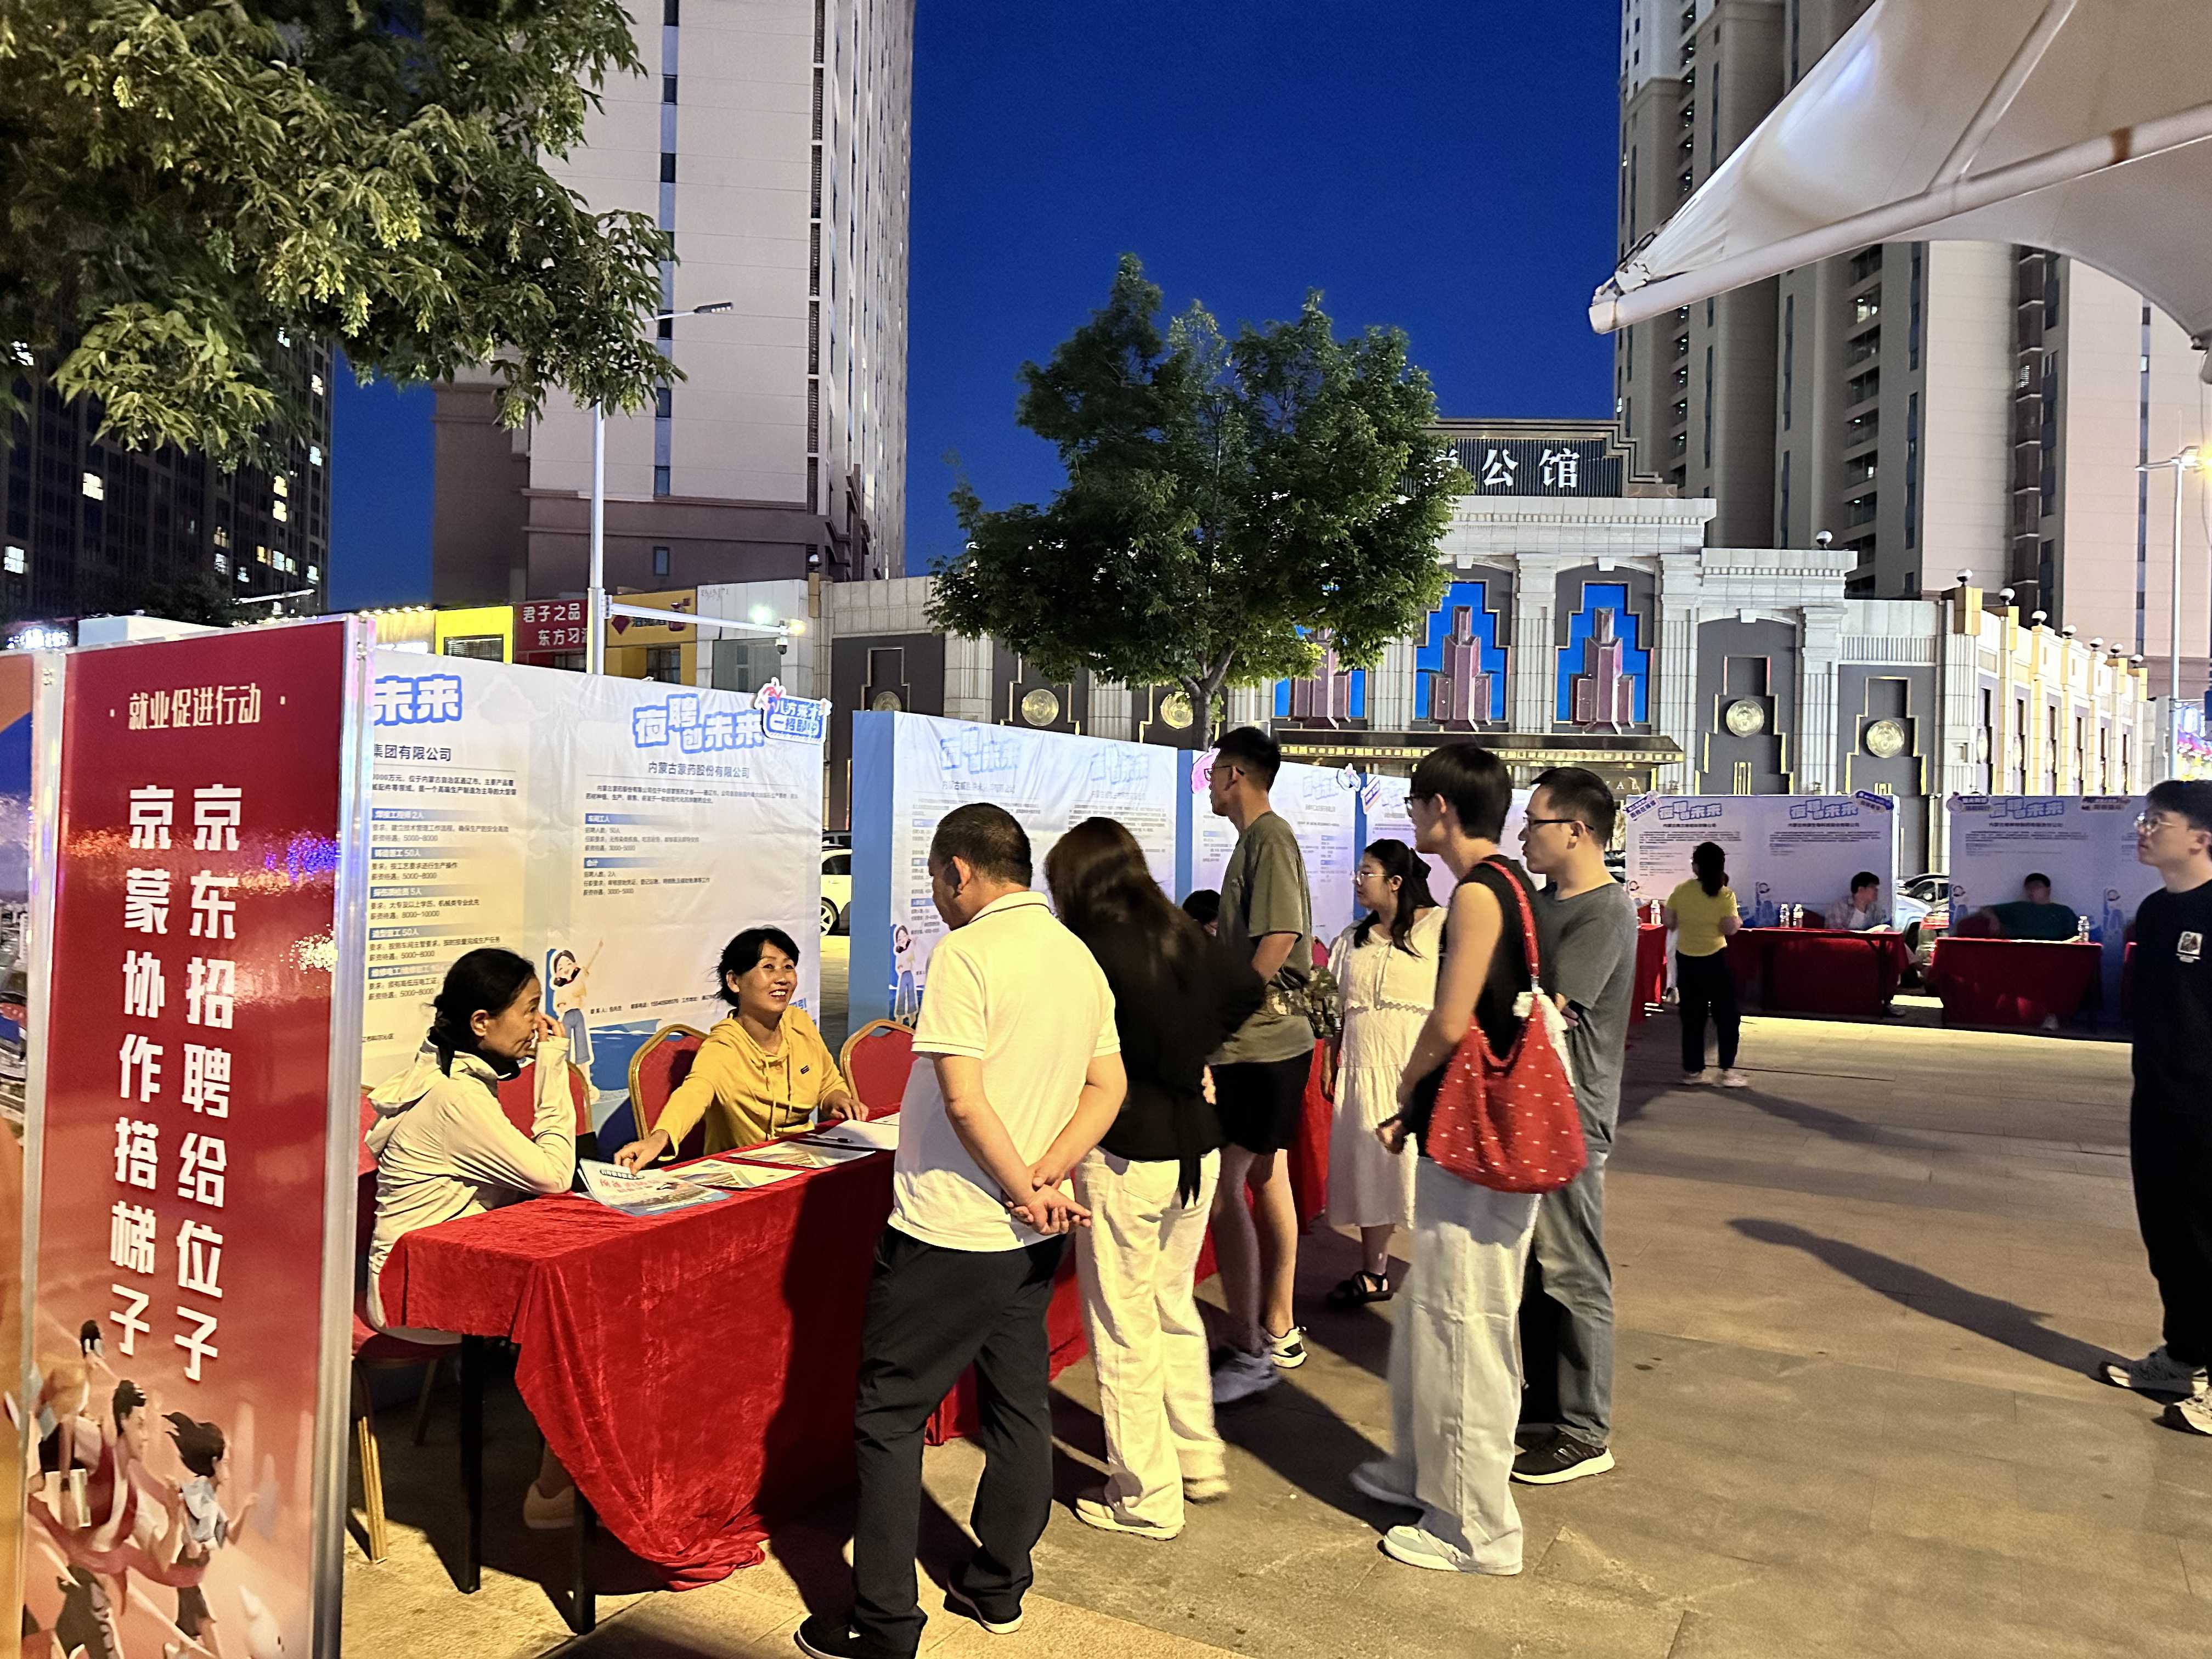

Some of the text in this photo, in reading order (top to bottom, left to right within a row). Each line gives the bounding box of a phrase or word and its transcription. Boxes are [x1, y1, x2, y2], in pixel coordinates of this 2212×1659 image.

[523, 603, 580, 623] 君子之品
[128, 682, 261, 730] 就业促进行动
[374, 674, 462, 726] 未来
[374, 743, 452, 761] 集团有限公司
[648, 761, 750, 779] 内蒙古蒙药股份有限公司
[109, 785, 174, 1356] 京蒙协作搭梯子
[174, 783, 242, 1381] 京东招聘给位子
